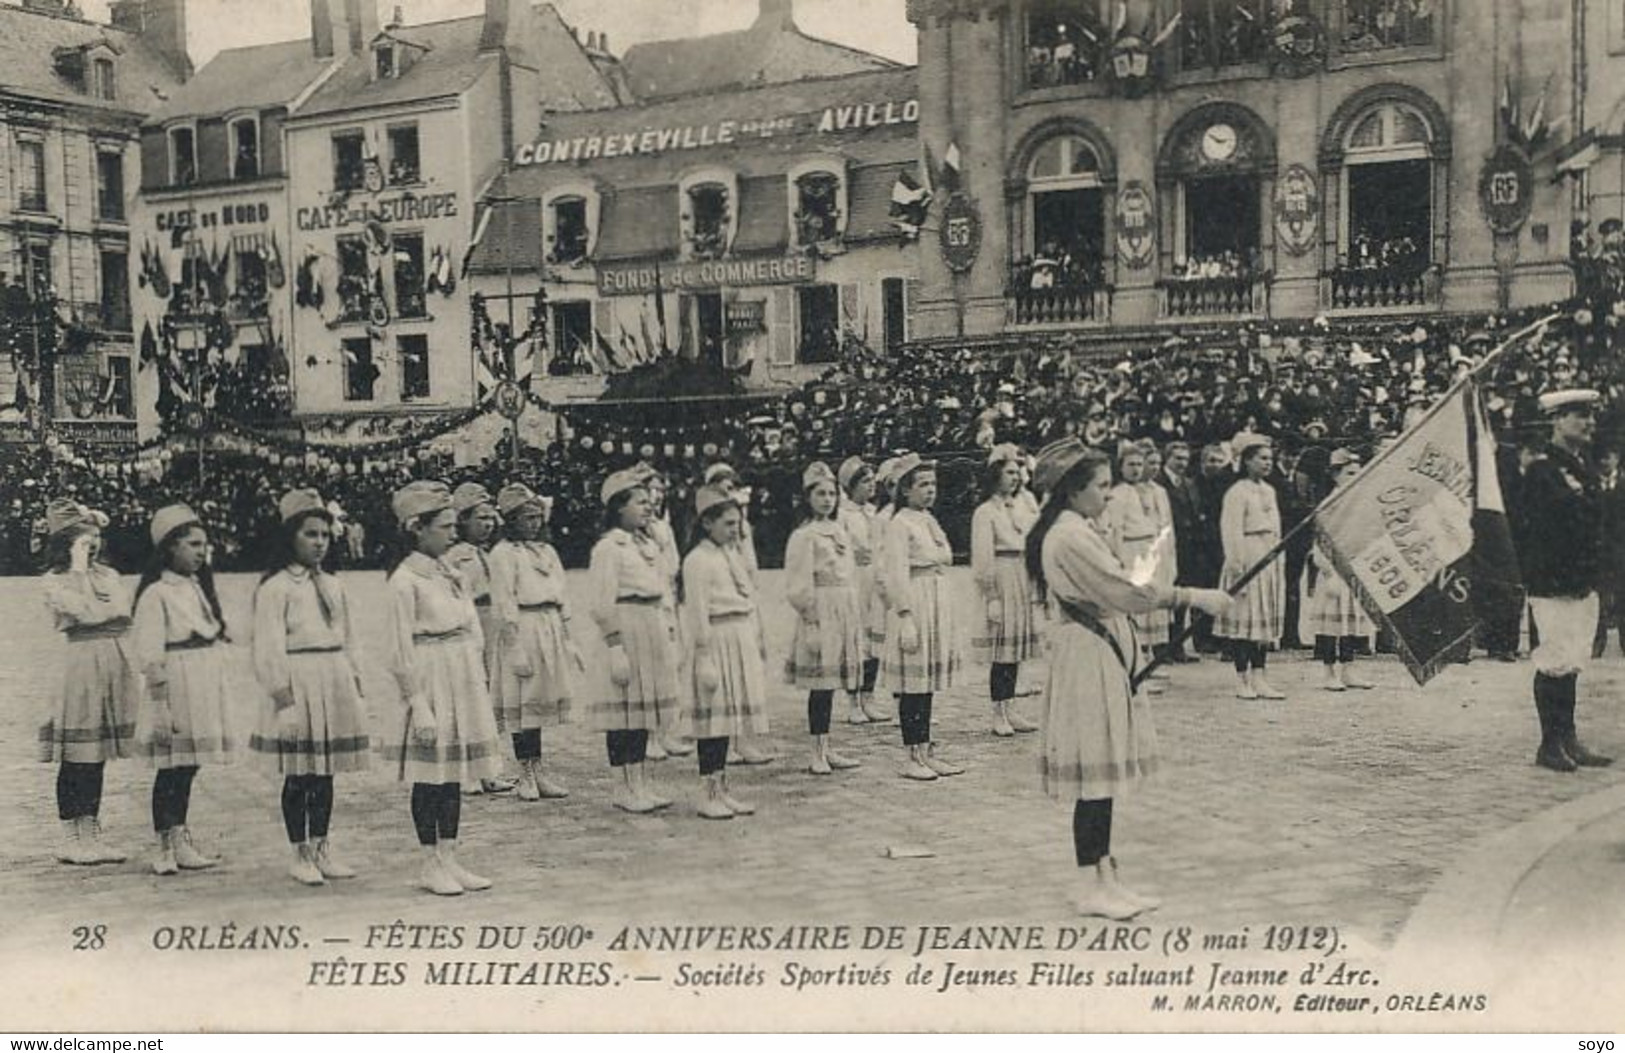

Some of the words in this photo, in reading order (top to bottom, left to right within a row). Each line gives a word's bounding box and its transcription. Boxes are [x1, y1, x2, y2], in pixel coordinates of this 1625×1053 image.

[222, 202, 269, 226] NORD
[671, 268, 694, 286] de
[699, 258, 809, 284] COMMERCE
